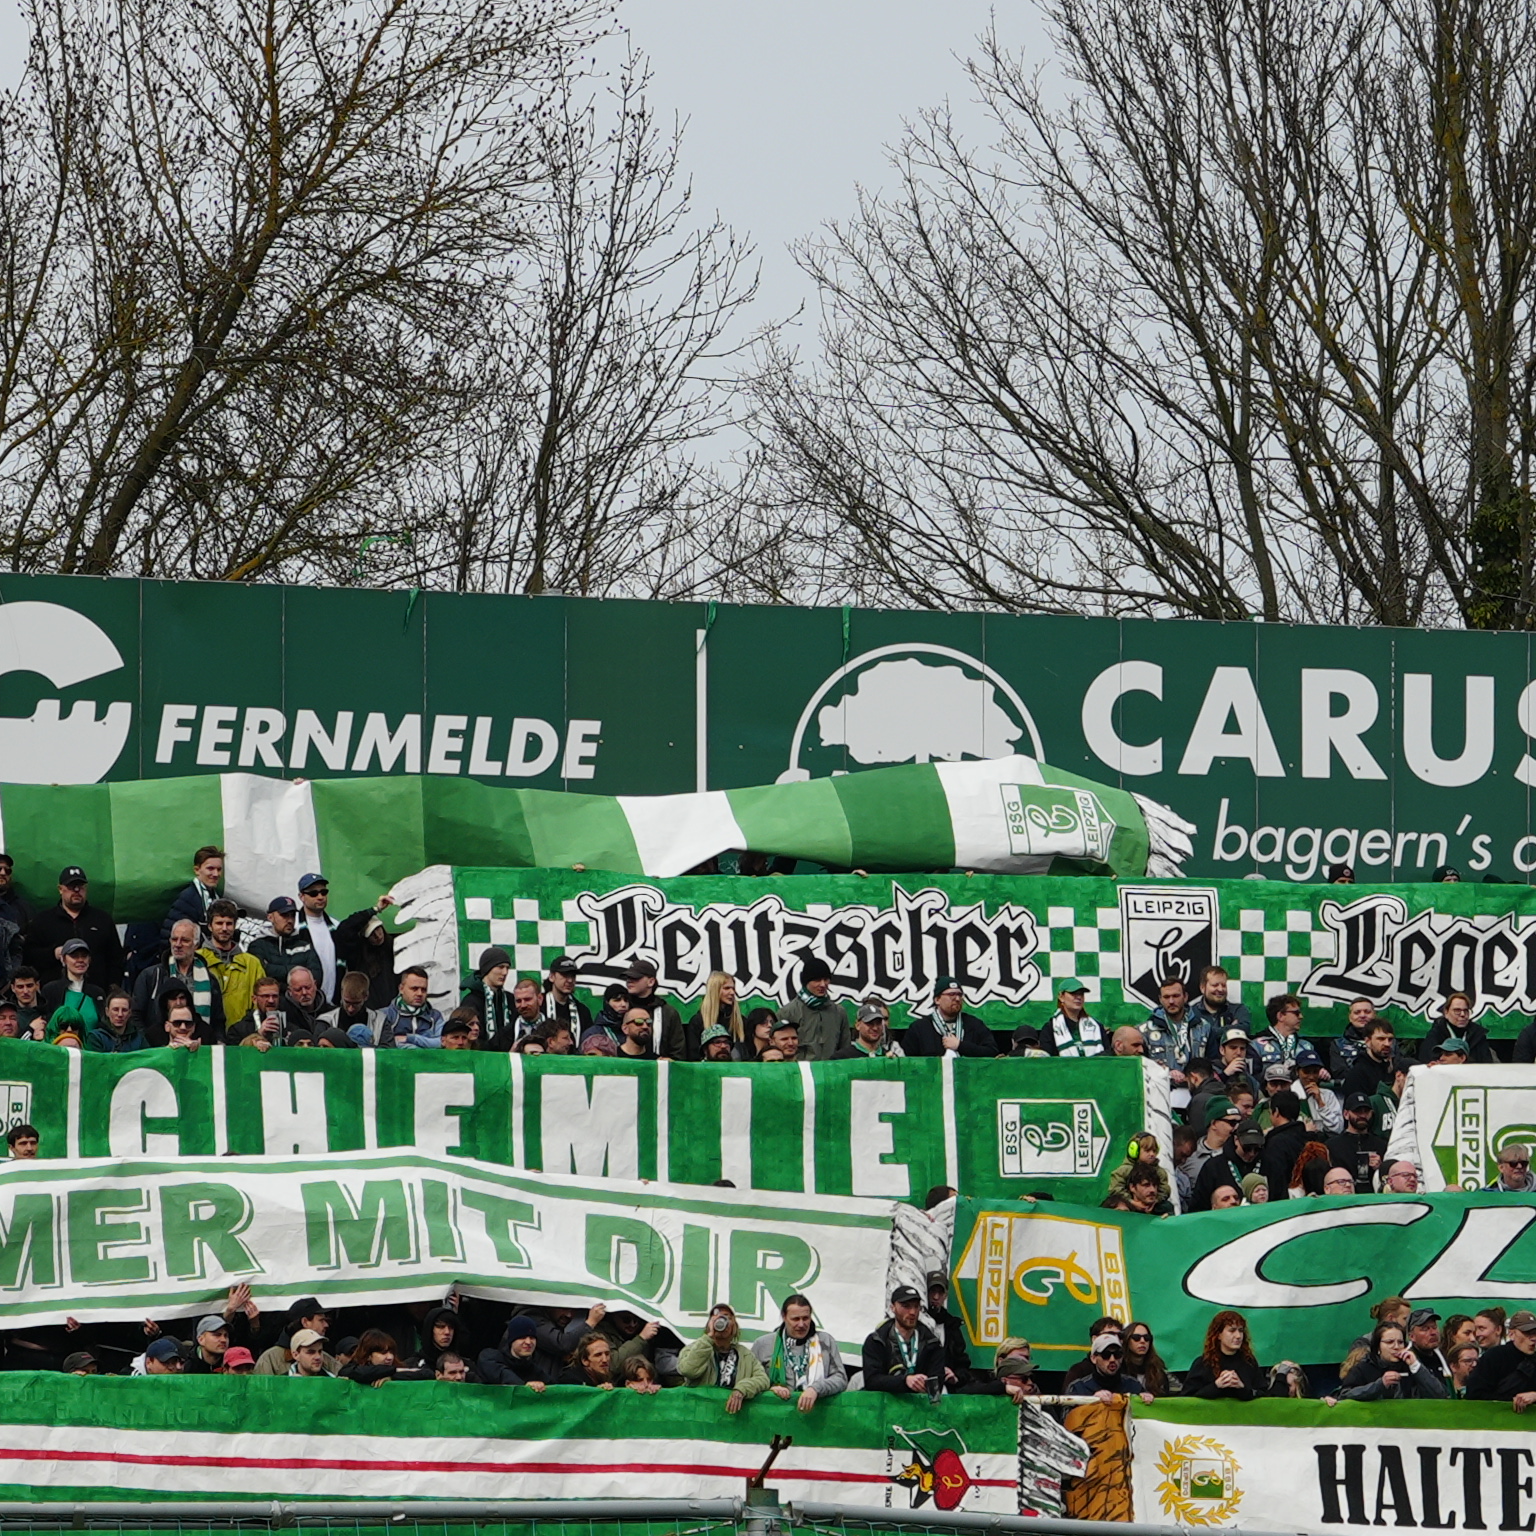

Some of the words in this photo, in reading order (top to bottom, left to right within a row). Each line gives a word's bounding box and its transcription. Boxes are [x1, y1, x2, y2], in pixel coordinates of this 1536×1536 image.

[155, 703, 603, 780] FERNMELDE
[1008, 801, 1024, 834] BSG
[1079, 797, 1100, 851] LEIPZIG
[1214, 798, 1491, 881] baggern's
[1132, 899, 1205, 917] LEIPZIG
[574, 886, 1037, 1012] Leutzscher
[11, 1102, 23, 1128] BS
[108, 1067, 910, 1197] CHEMIE
[1005, 1120, 1017, 1155] BSG
[1078, 1108, 1090, 1168] LEIPZIG
[1461, 1098, 1480, 1192] LEIPZIG
[301, 1177, 541, 1271] MIT
[585, 1213, 825, 1329] DIR
[984, 1222, 1004, 1338] LEIPZIG
[1104, 1252, 1126, 1328] BSG
